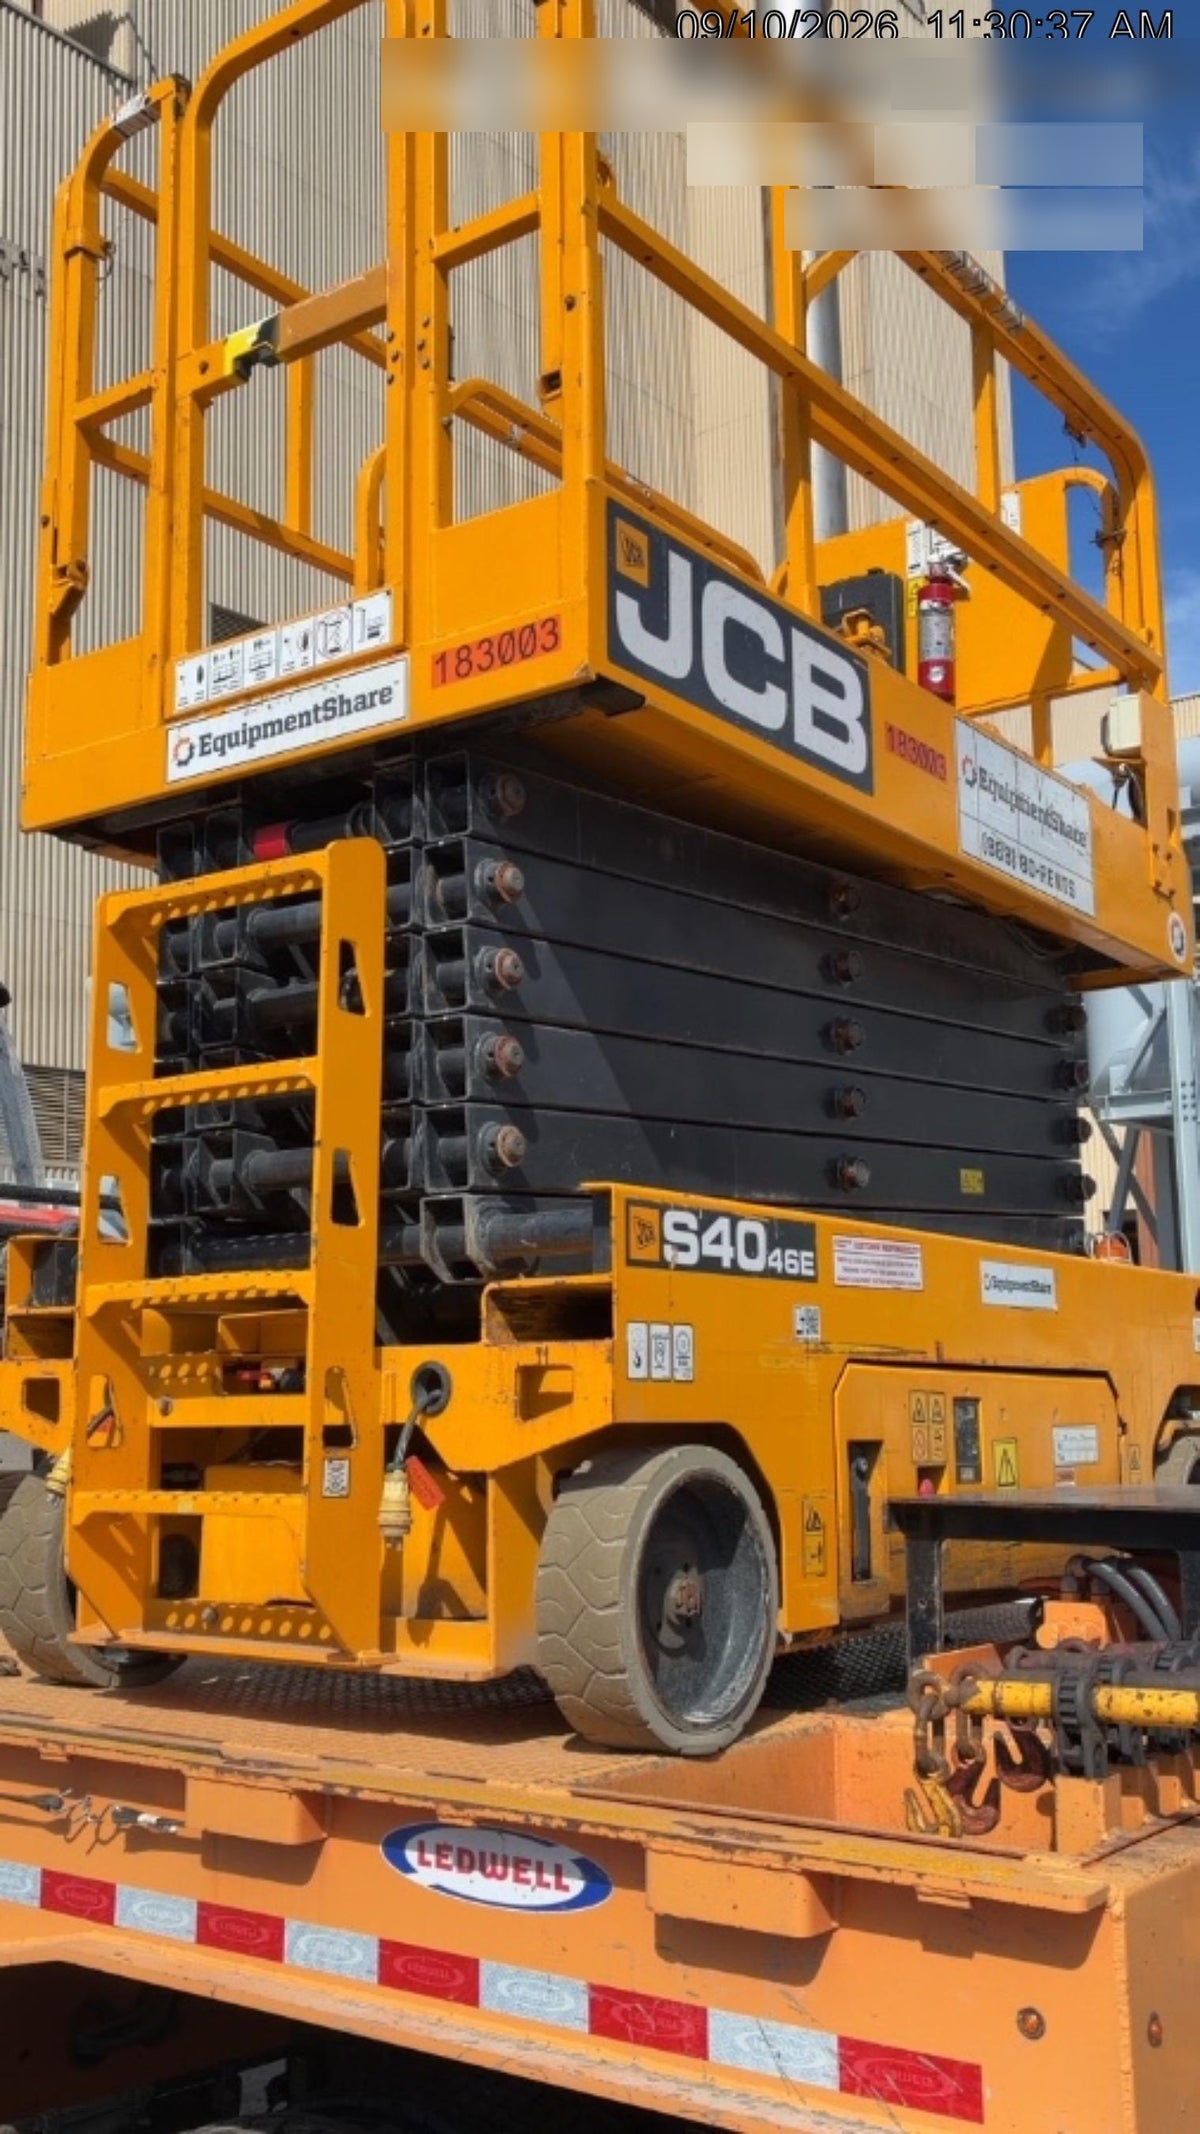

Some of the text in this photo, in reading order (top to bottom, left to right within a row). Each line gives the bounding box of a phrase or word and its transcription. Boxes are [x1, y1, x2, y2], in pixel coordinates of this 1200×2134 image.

[435, 616, 559, 684] 183003
[616, 549, 867, 774] JCB
[198, 685, 393, 757] EquipmentShare
[979, 766, 1087, 847] EquipmentShare
[663, 1209, 767, 1273] S40
[767, 1248, 816, 1276] 46E
[416, 1840, 571, 1893] LEDWELL
